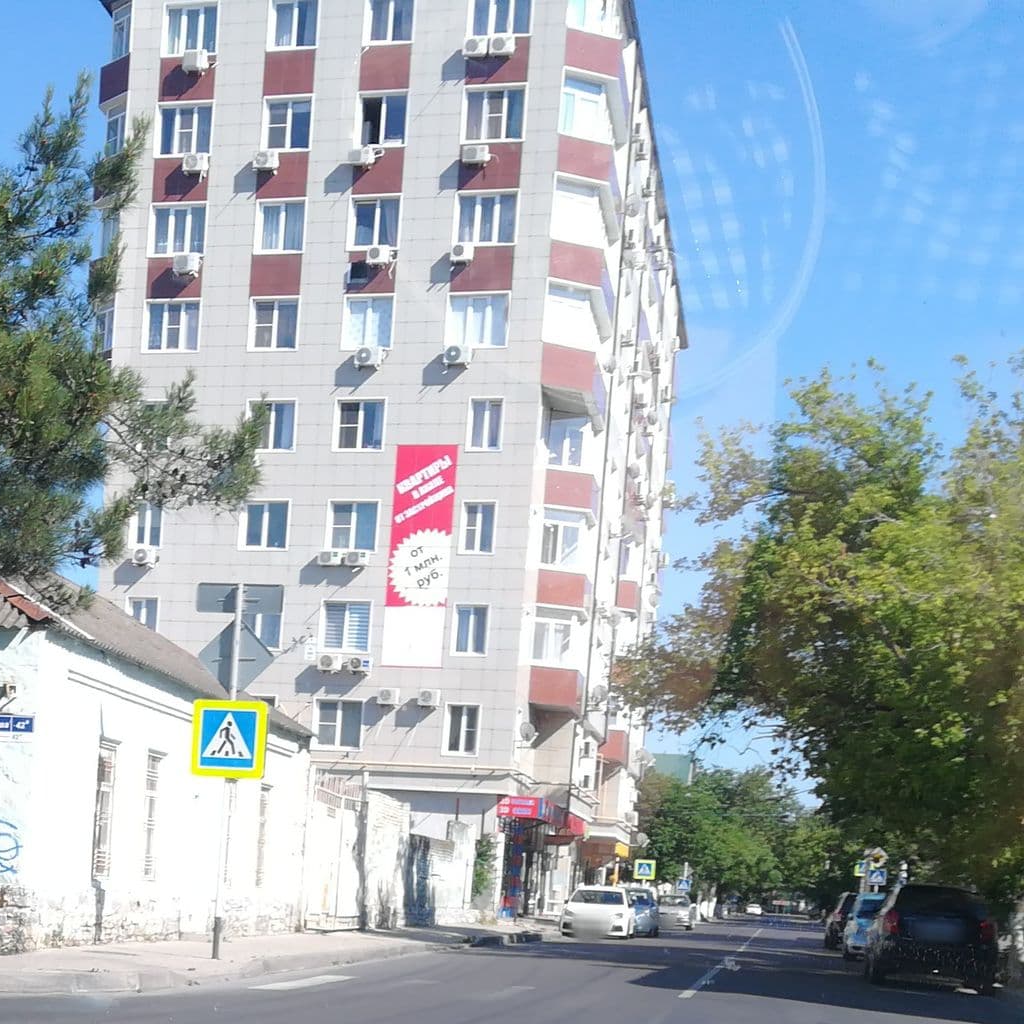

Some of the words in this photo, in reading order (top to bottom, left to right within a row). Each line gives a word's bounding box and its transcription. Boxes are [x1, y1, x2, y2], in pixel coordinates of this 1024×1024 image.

[410, 546, 424, 557] от
[404, 567, 412, 576] 1
[416, 569, 444, 589] руб.
